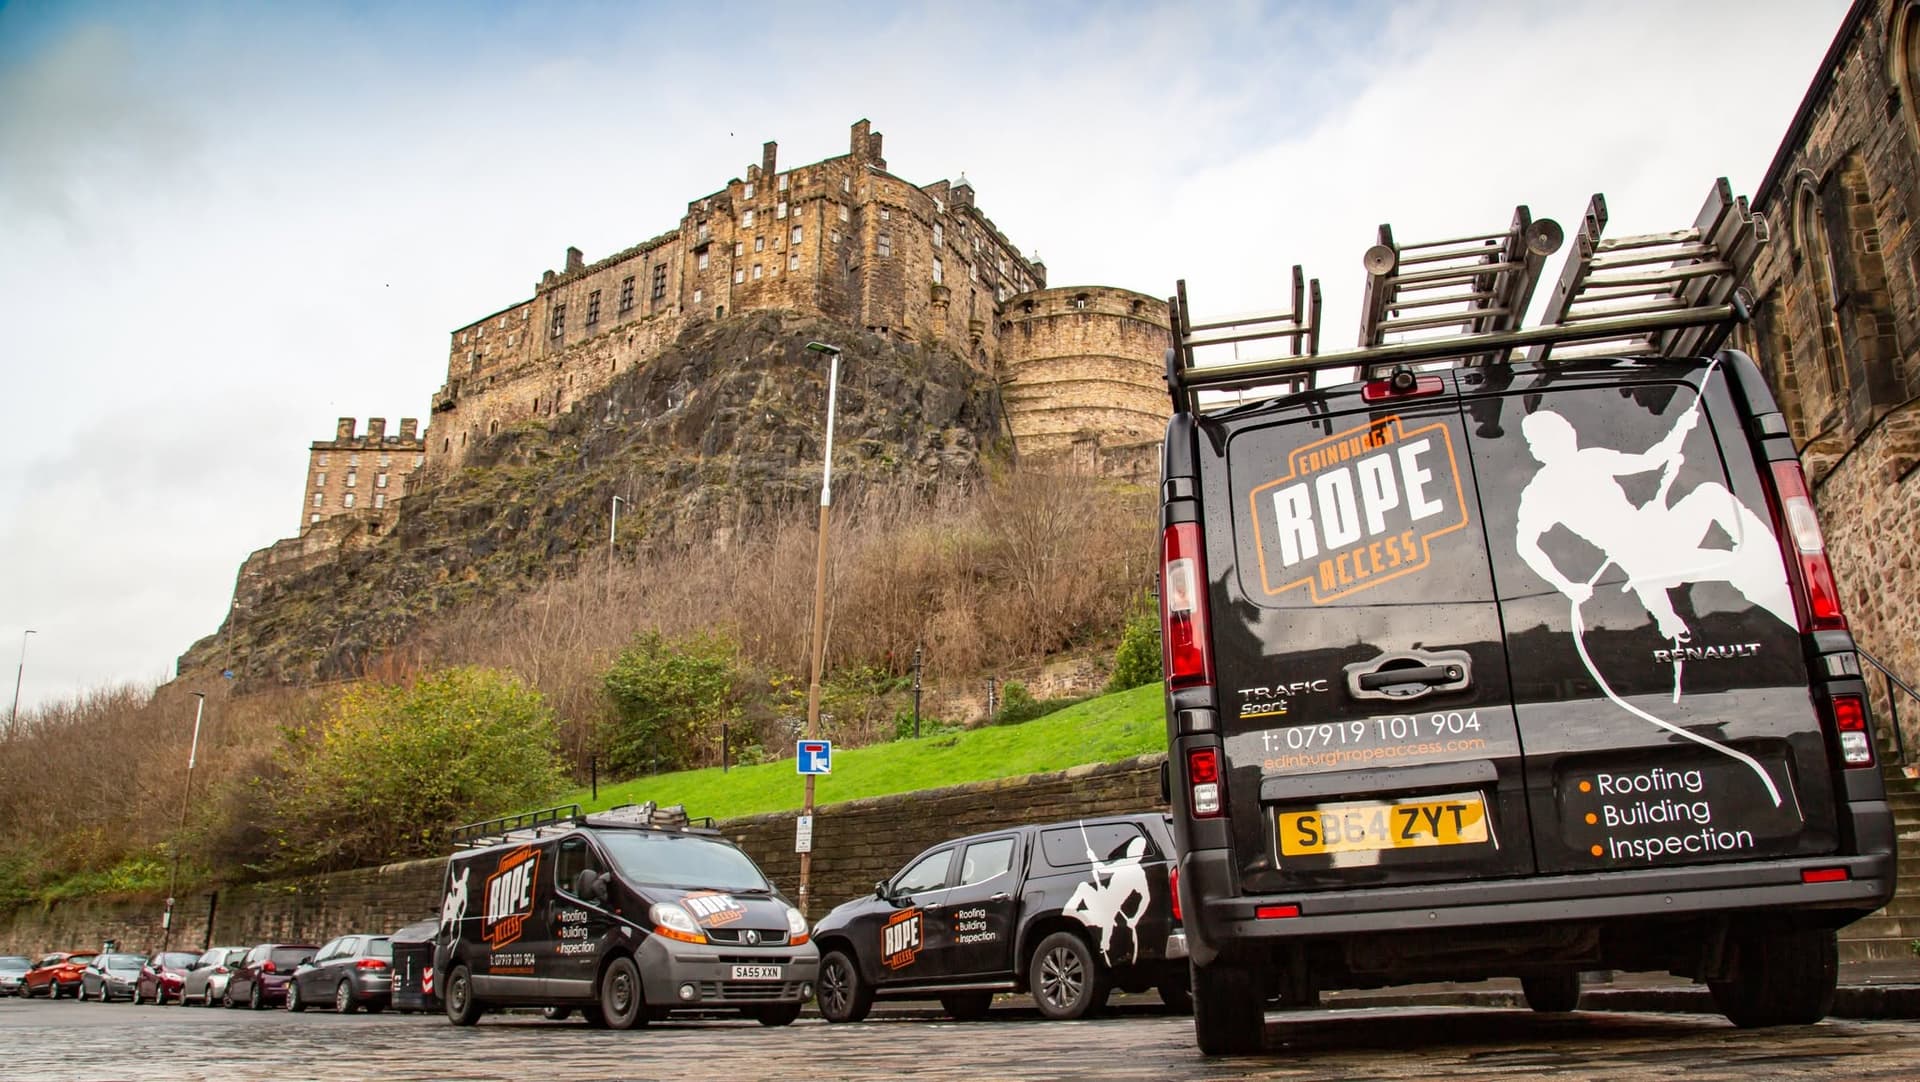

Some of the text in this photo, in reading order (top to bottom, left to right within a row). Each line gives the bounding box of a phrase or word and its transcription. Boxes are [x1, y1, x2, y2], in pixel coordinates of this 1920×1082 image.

[1300, 426, 1395, 475] EDINBURGH
[1273, 438, 1443, 567] ROPE
[1319, 530, 1417, 591] ACCESS
[1653, 643, 1761, 663] RENAULT
[1238, 680, 1328, 700] TRAFIC
[1239, 699, 1288, 715] Sport
[1262, 711, 1481, 751] t: 07919 101 904
[1264, 737, 1486, 770] edinburghropeaccess.com
[1597, 768, 1703, 796] Roofing
[1296, 804, 1468, 847] SB64 ZYT
[1603, 799, 1711, 827] Building
[1609, 827, 1754, 861] Inspection
[487, 858, 535, 926] ROPE
[561, 909, 588, 923] Roofing
[960, 908, 986, 920] Roofing
[960, 920, 987, 932] Building
[562, 924, 588, 939] Building
[885, 917, 919, 956] ROPE
[960, 931, 996, 944] Inspection
[560, 941, 595, 956] Inspection
[736, 967, 778, 977] SA55 XXN
